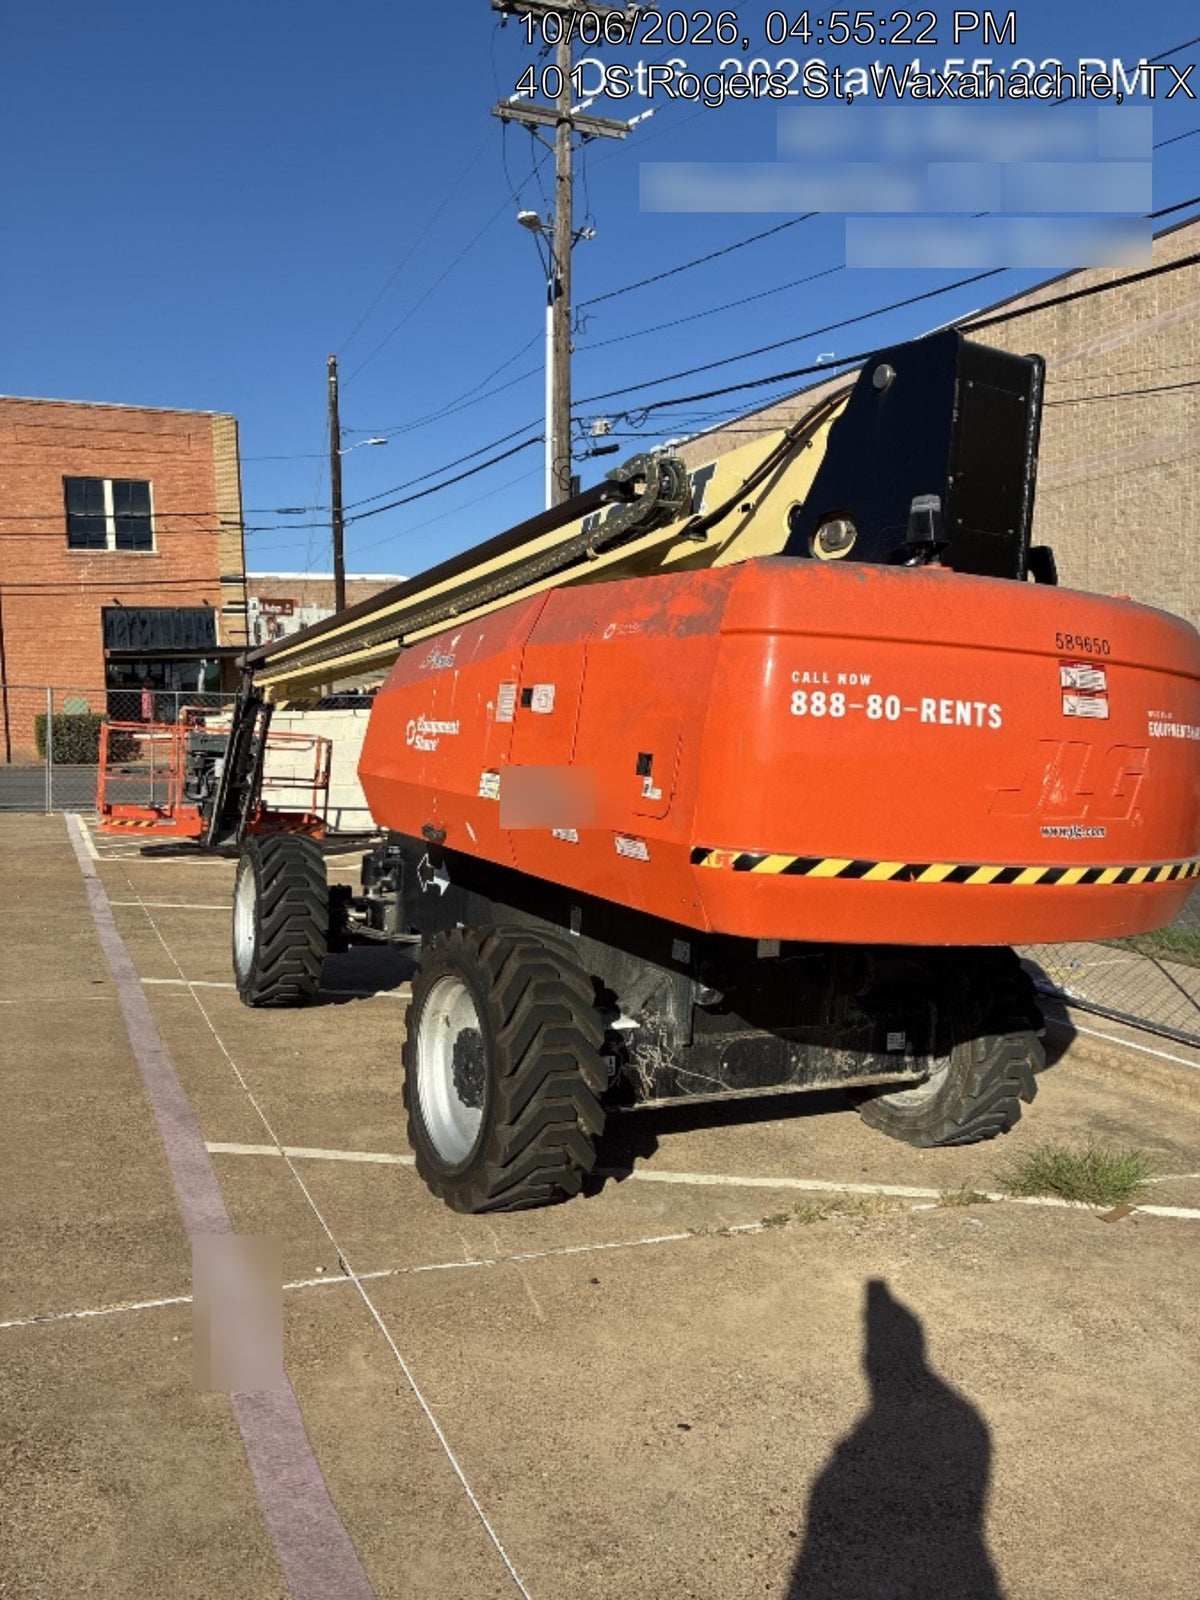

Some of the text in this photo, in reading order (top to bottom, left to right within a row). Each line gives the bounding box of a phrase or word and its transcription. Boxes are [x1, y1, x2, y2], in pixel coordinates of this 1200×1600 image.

[1055, 632, 1111, 655] 589650
[791, 671, 872, 686] CALL NOW
[790, 690, 1002, 730] 888-80-RENTS
